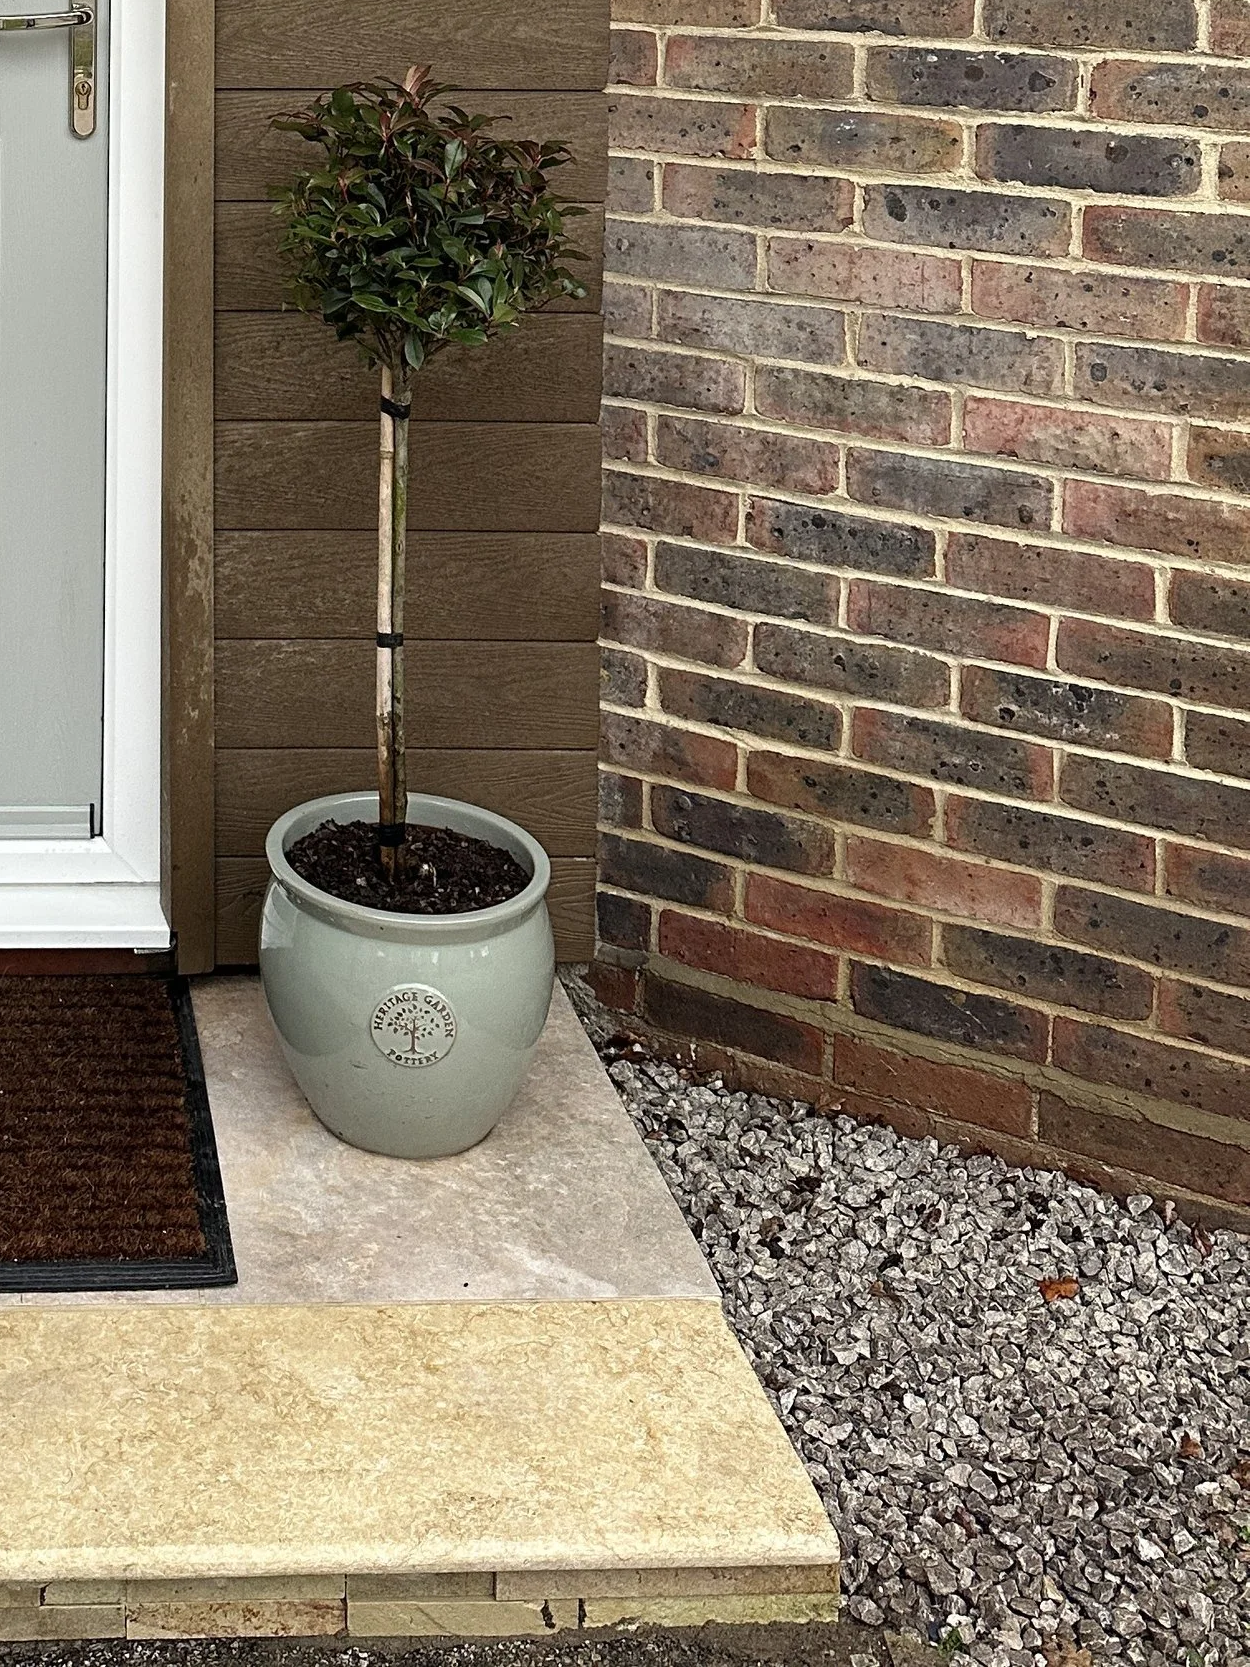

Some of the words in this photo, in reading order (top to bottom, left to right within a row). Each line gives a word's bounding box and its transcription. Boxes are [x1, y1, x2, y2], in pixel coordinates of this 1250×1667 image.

[374, 991, 419, 1031] HERITAGE
[423, 995, 454, 1038] GARDEN
[386, 1048, 439, 1066] POTTERY
